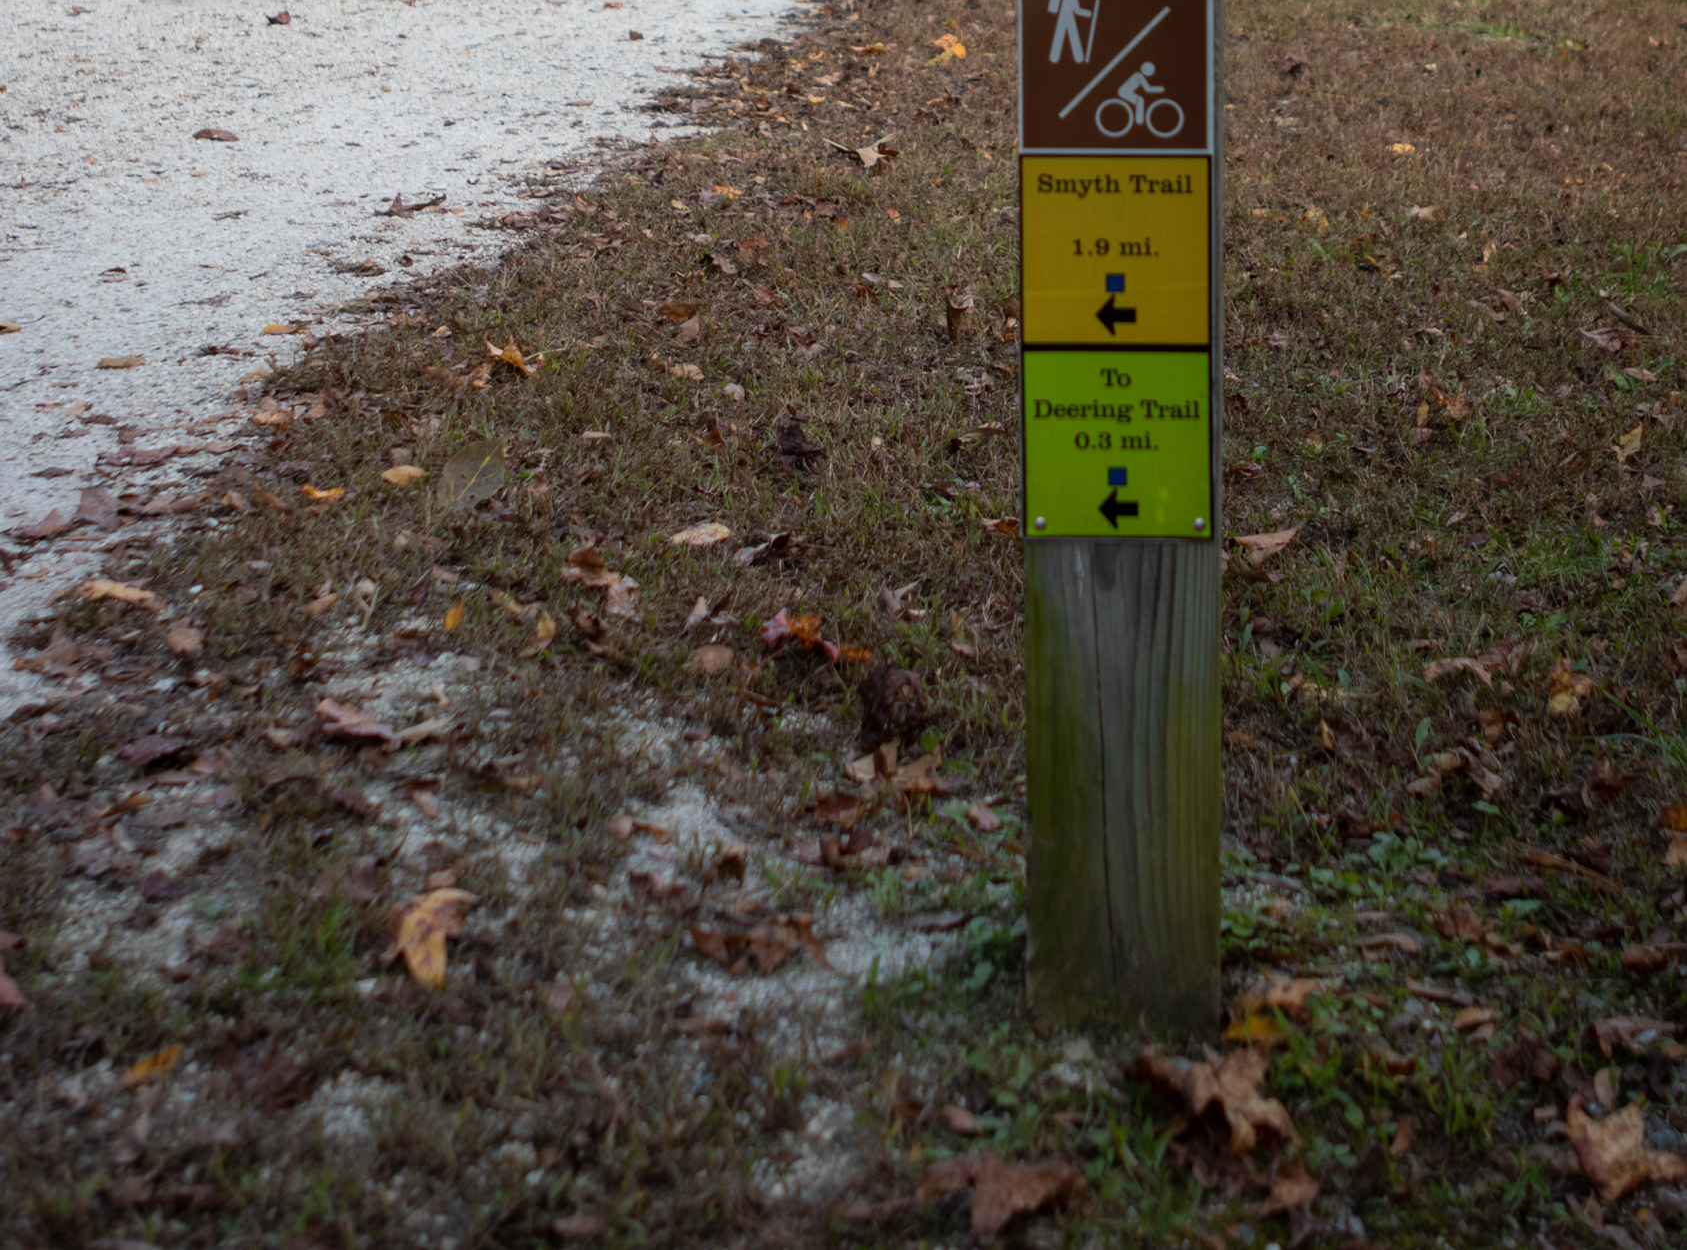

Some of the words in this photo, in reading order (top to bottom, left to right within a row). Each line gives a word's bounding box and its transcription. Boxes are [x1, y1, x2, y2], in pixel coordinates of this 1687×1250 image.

[1037, 173, 1120, 198] Smyth
[1129, 174, 1193, 194] Trail
[1073, 238, 1110, 256] 1.9
[1119, 237, 1159, 257] mi.
[1101, 368, 1132, 387] To
[1033, 399, 1134, 424] Deering
[1140, 400, 1200, 419] Trail
[1074, 432, 1112, 450] 0.3
[1121, 431, 1159, 450] mi.
